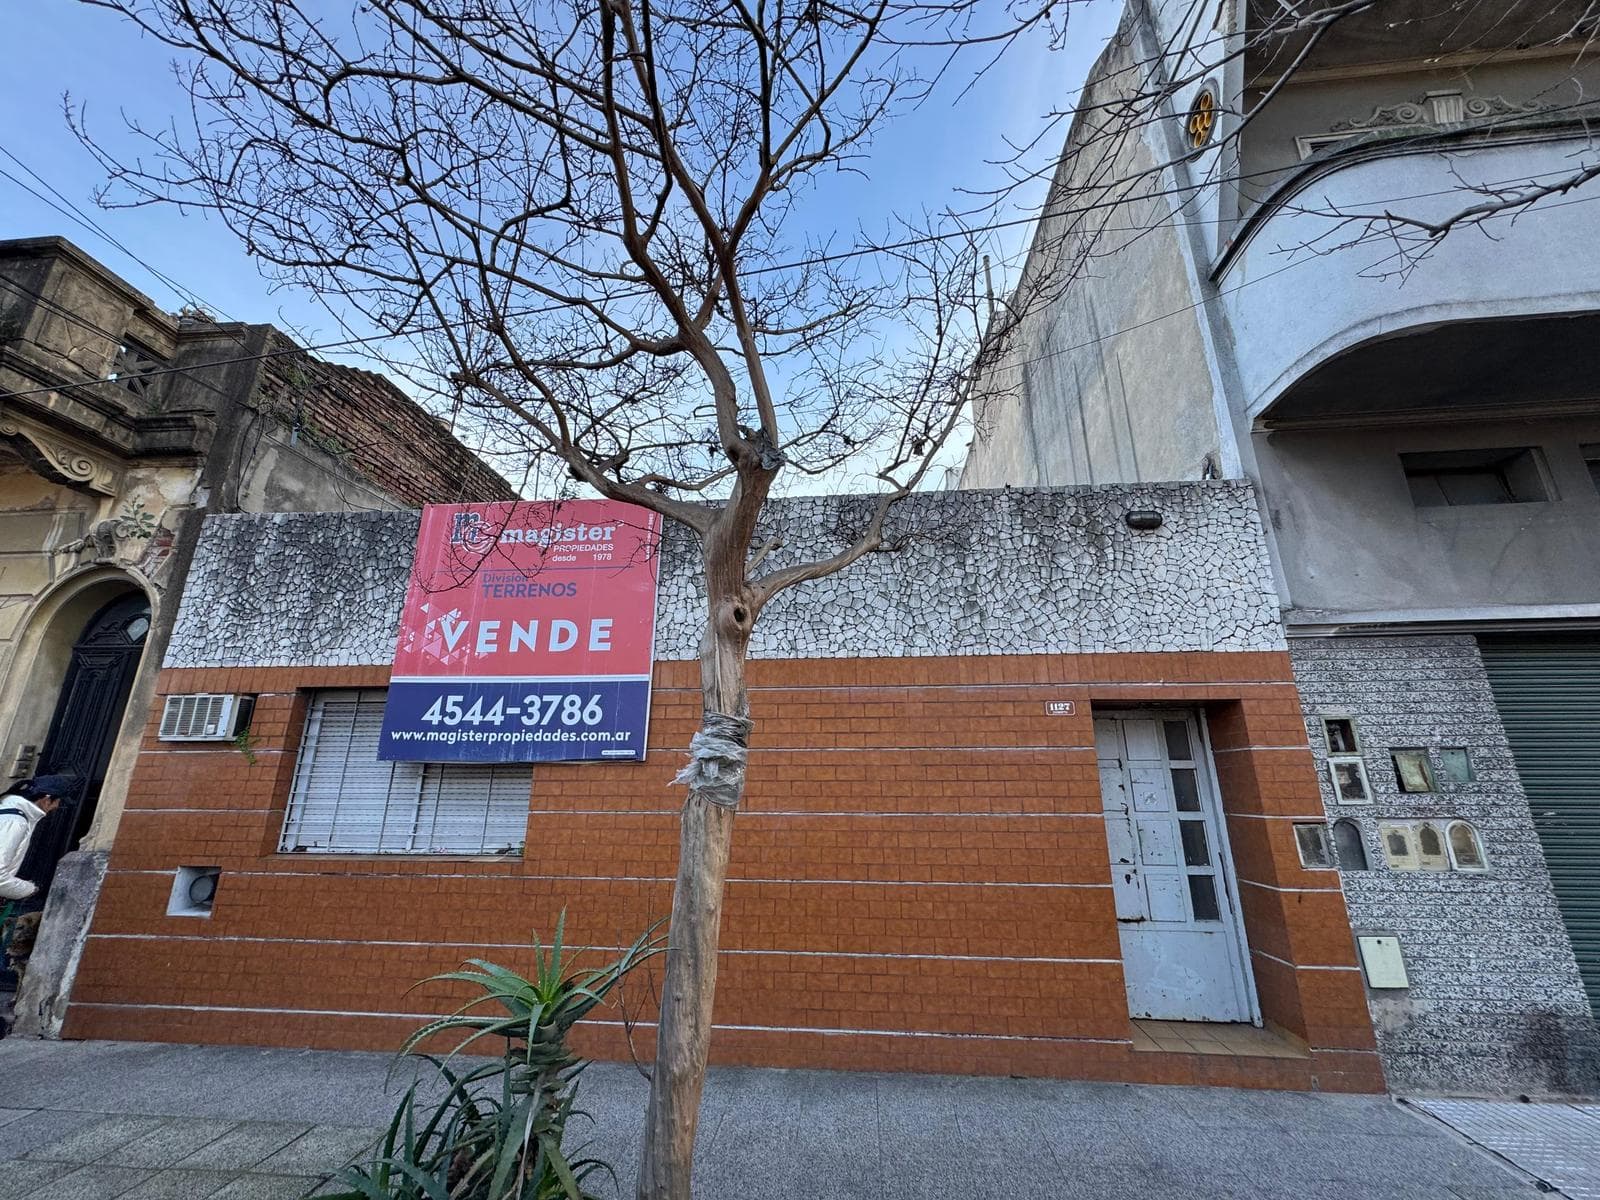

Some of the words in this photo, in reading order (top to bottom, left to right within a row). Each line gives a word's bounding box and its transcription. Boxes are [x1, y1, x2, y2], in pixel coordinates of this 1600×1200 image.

[501, 522, 617, 549] magister
[553, 543, 614, 553] PROPIEDADES
[592, 553, 612, 561] 1978
[481, 582, 577, 599] TERRENOS
[440, 618, 613, 653] VENDE
[421, 695, 603, 726] 4544-3786
[1050, 703, 1070, 711] 1127
[391, 728, 631, 745] www.magisterpropiedades.com.ar
